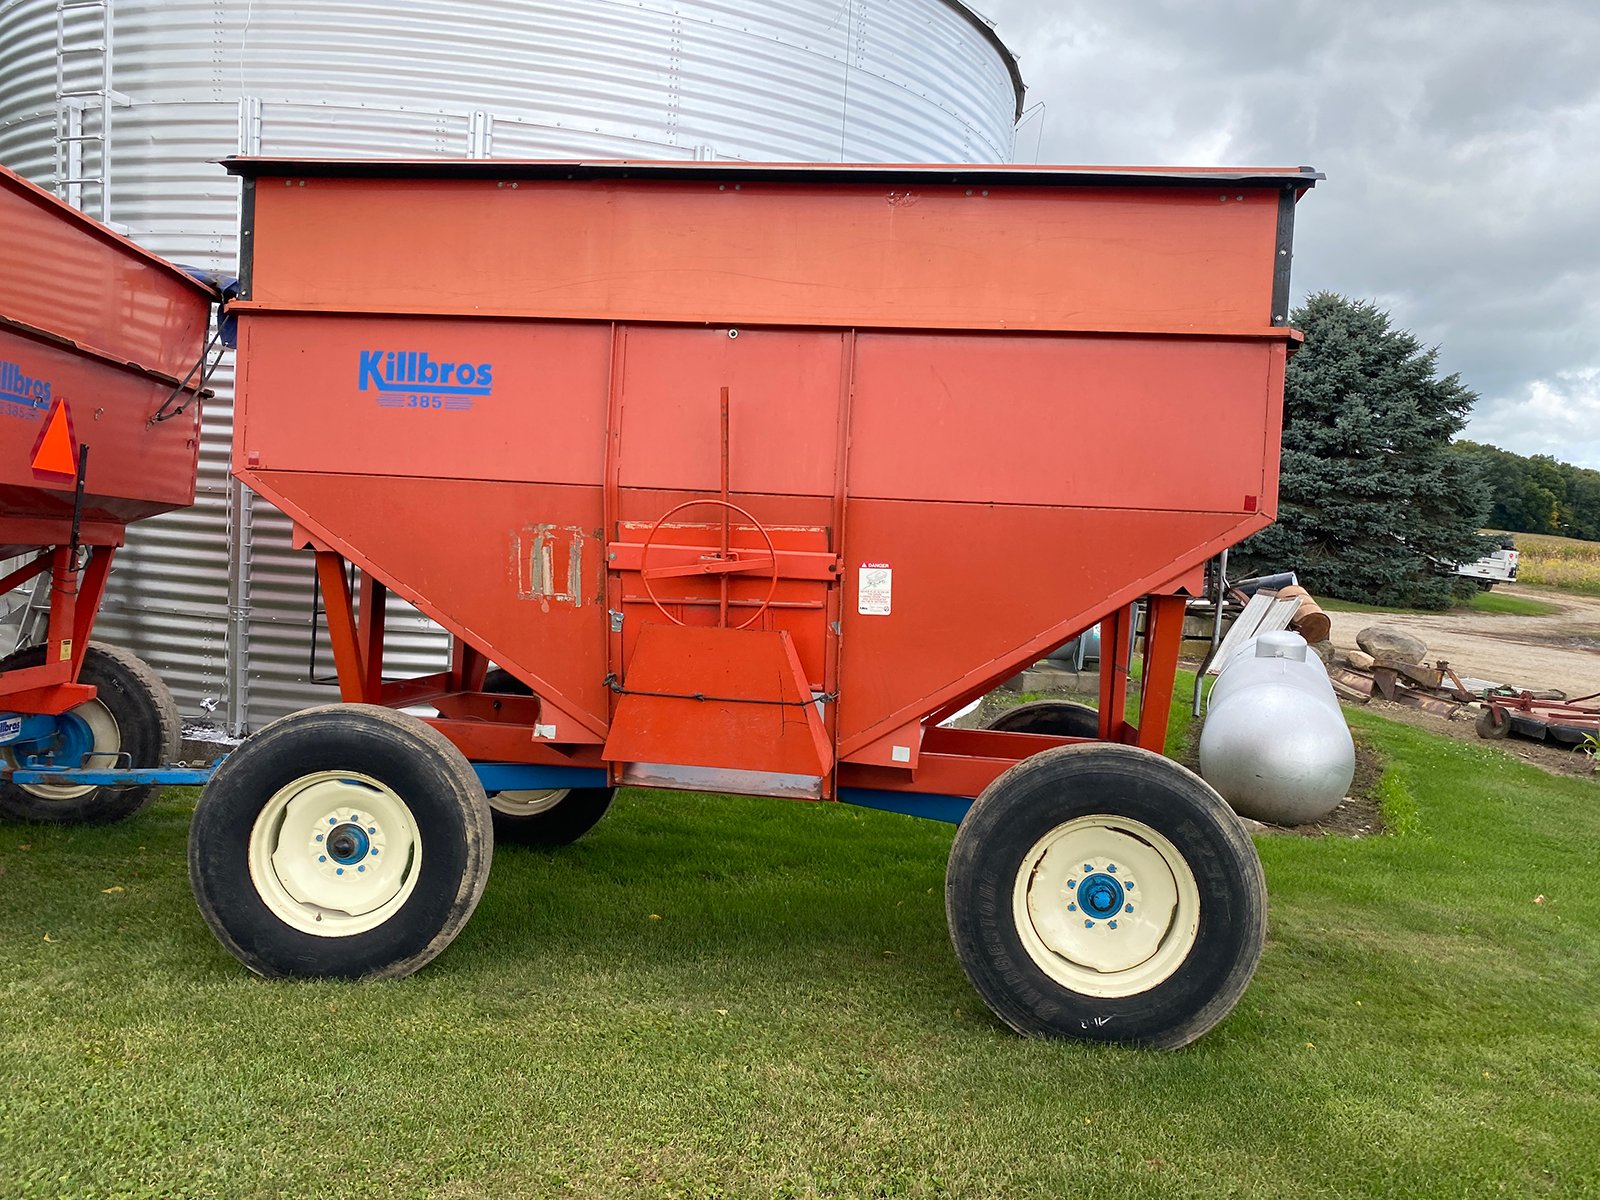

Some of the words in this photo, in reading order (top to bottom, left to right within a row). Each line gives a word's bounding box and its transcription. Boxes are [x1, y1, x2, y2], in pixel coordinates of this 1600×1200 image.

[0, 361, 51, 401] llbros
[358, 351, 493, 393] Killbros
[407, 395, 442, 408] 385
